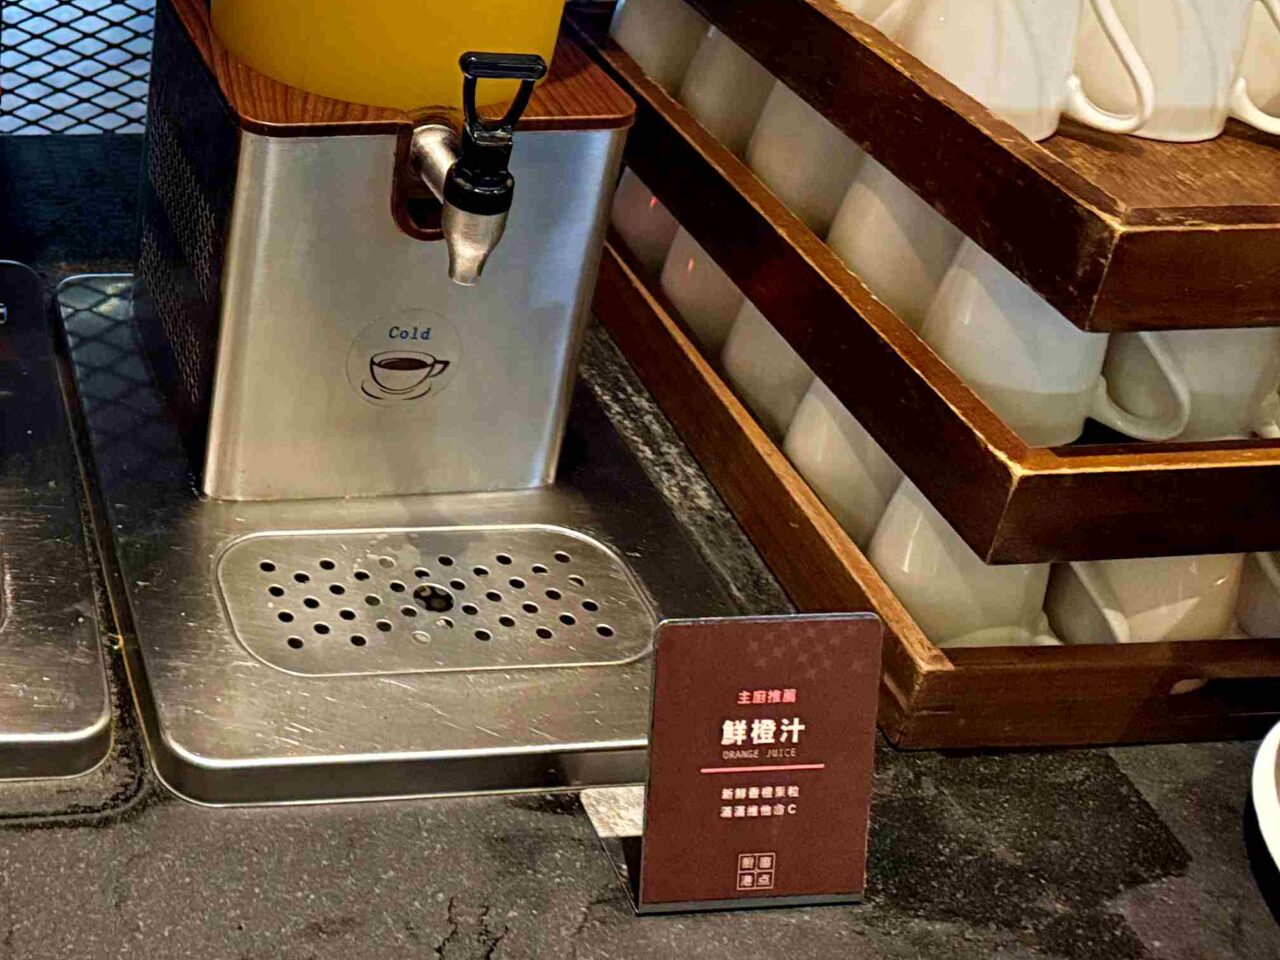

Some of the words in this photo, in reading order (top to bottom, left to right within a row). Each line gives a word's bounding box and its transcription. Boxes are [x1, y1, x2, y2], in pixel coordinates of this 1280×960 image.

[388, 326, 432, 340] Cold
[737, 688, 797, 705] 主廚推薦
[720, 717, 806, 746] 鮮橙汁
[722, 750, 760, 760] ORANGE
[765, 748, 797, 759] JUICE
